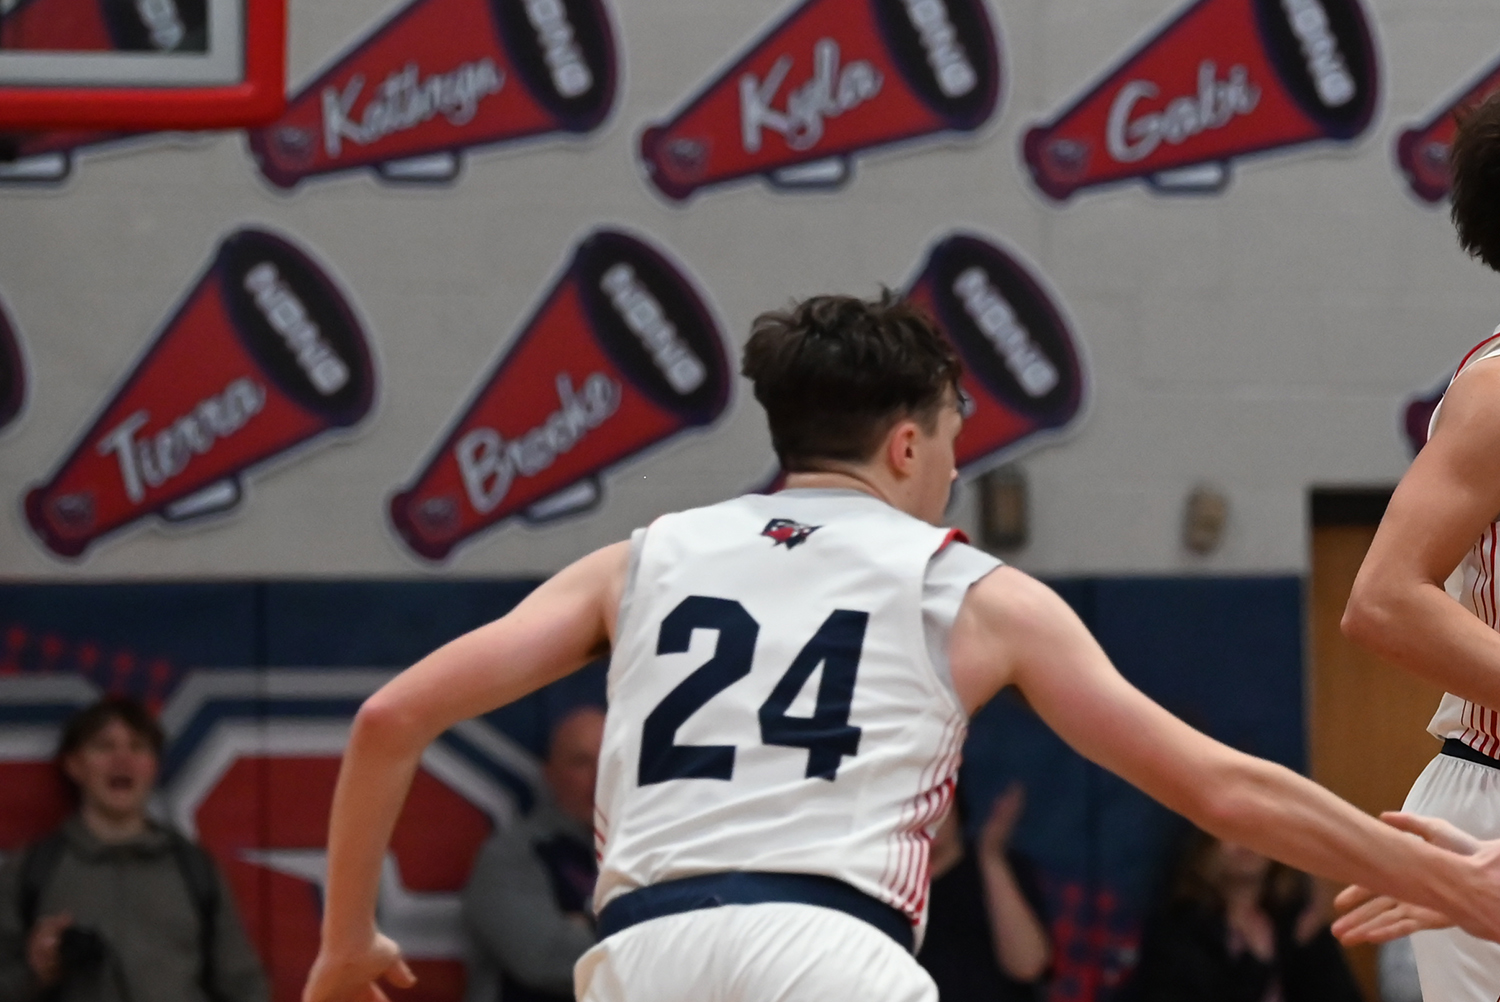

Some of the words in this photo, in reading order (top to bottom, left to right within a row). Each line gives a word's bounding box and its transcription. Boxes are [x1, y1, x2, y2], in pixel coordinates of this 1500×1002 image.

[741, 39, 881, 152] Kyla
[1107, 62, 1258, 161] Gabi
[99, 378, 265, 501] Tierra
[457, 373, 620, 511] Brooke
[638, 595, 869, 786] 24
